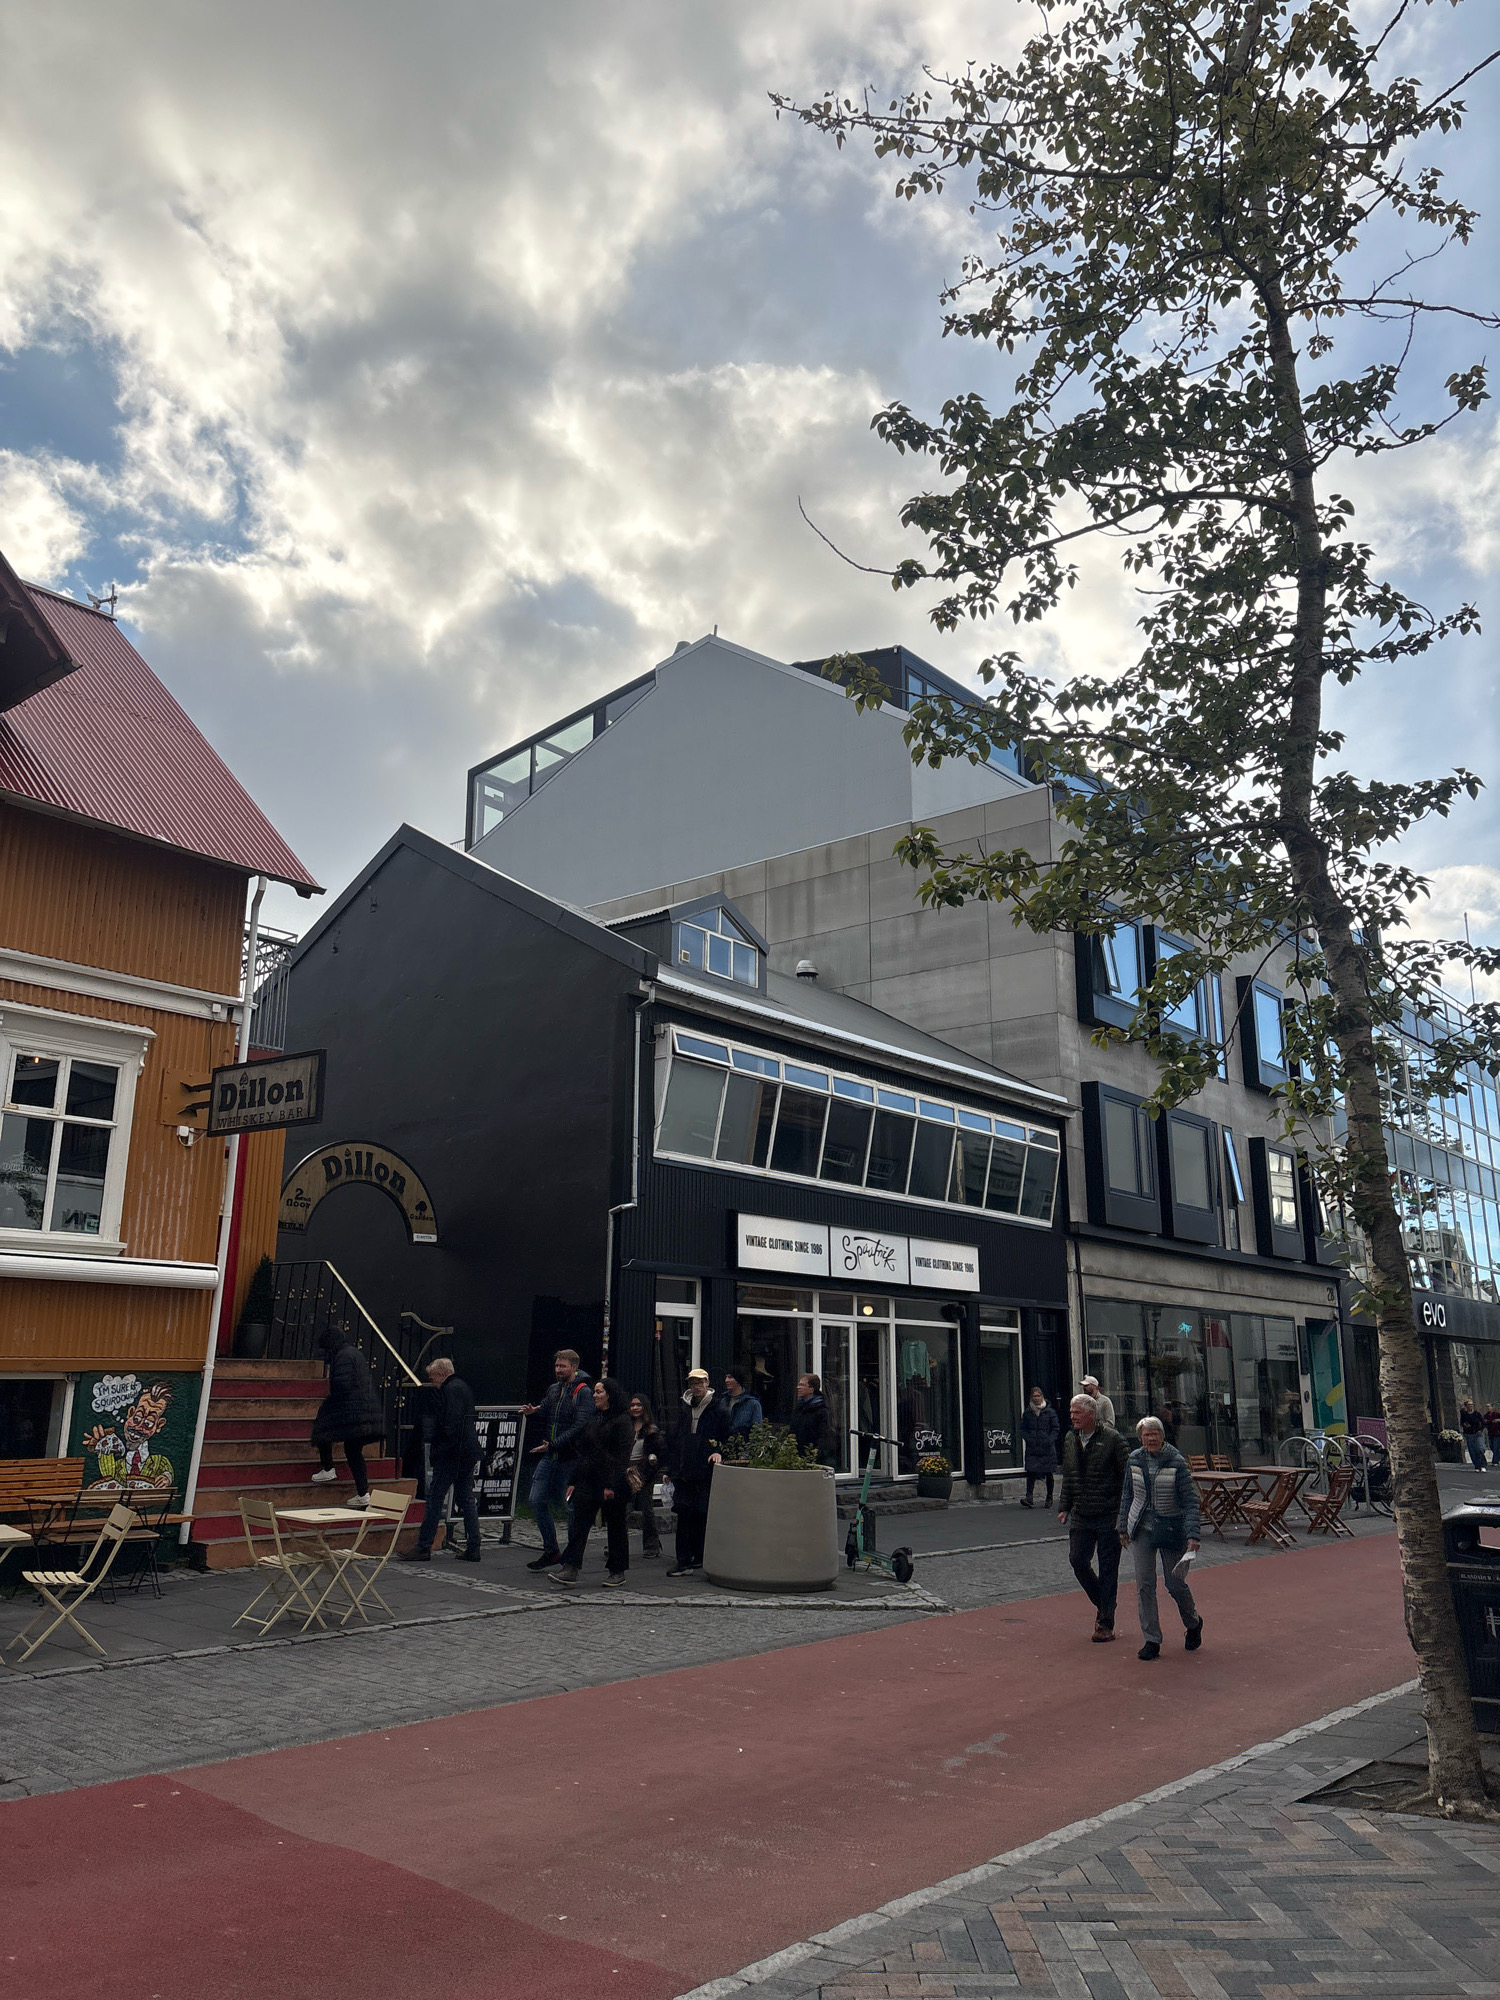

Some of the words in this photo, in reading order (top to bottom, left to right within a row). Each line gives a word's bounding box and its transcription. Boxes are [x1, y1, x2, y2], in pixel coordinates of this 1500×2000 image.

[219, 1071, 304, 1112] Dillon
[217, 1112, 274, 1128] WHISKEY
[279, 1107, 303, 1120] BAR
[322, 1148, 406, 1194] Dillon
[286, 1198, 311, 1208] floor
[745, 1235, 767, 1248] VINTAGE
[768, 1238, 793, 1251] CLOTHING
[794, 1241, 809, 1253] SINCE
[811, 1243, 823, 1255] 1986
[915, 1257, 931, 1268] VINTAGE
[933, 1259, 951, 1270] CLOTHING
[952, 1261, 963, 1272] SINCE
[1326, 1287, 1334, 1301] 28
[1423, 1301, 1446, 1327] eva
[111, 1383, 129, 1394] SURE
[474, 1421, 489, 1434] PPY
[499, 1421, 516, 1434] UNTIL
[496, 1435, 515, 1448] 19:00
